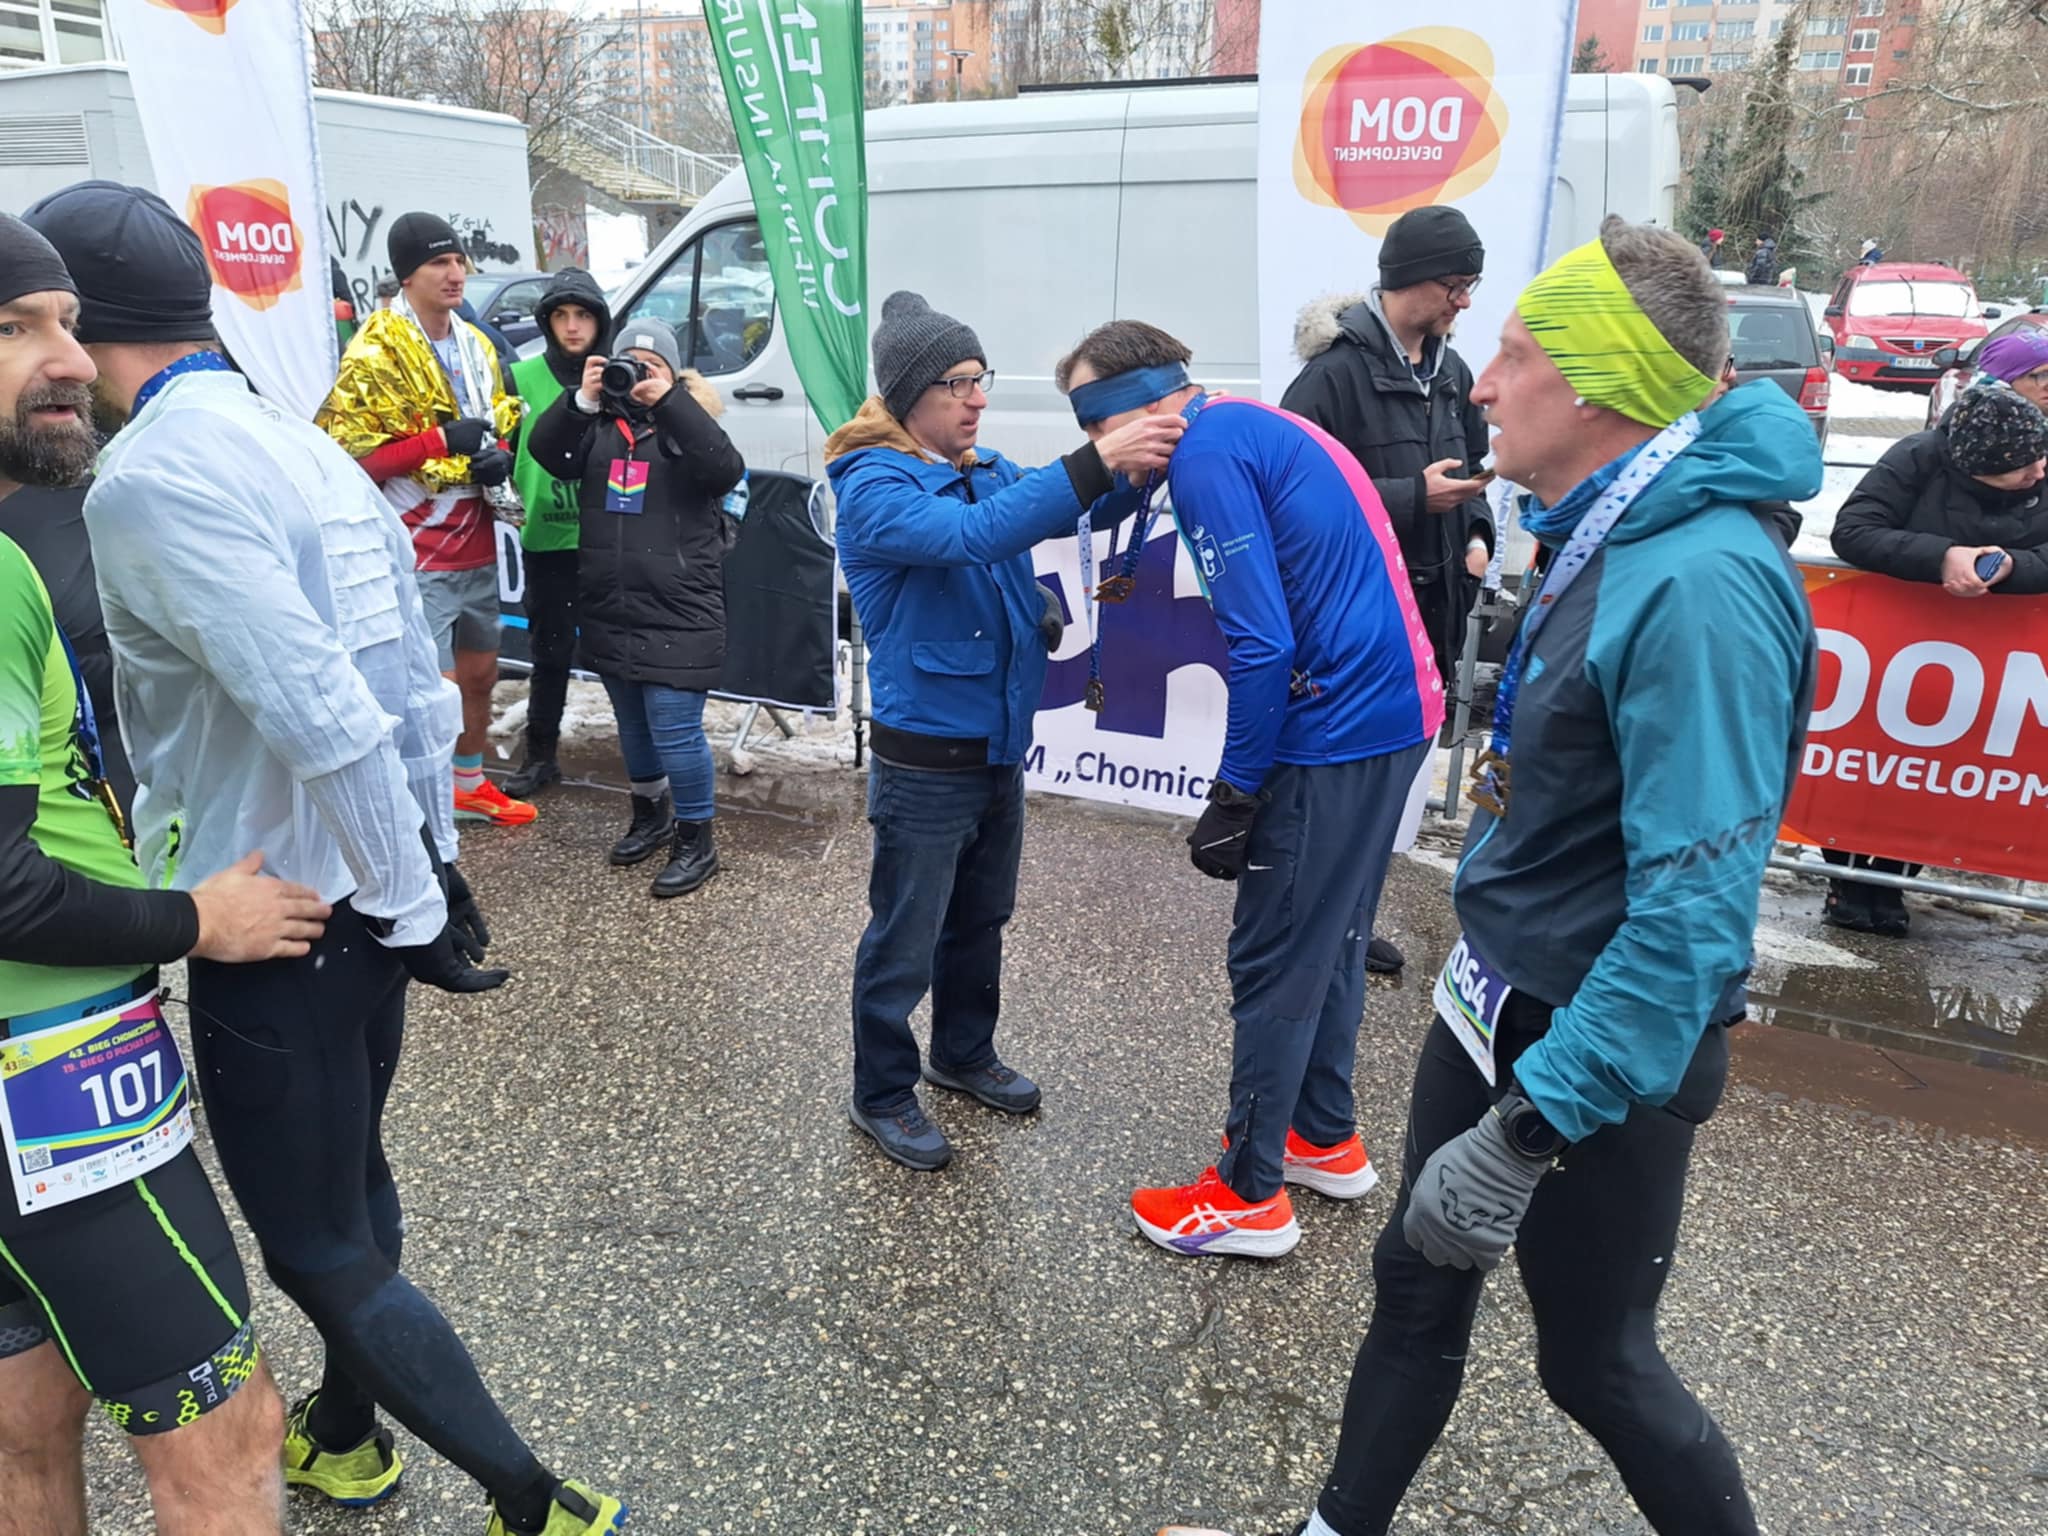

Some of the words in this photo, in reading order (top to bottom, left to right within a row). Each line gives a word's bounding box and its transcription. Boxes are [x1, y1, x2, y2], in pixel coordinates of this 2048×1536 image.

[87, 1039, 111, 1054] BIEG
[80, 1054, 105, 1069] BIEG
[80, 1050, 162, 1127] 107
